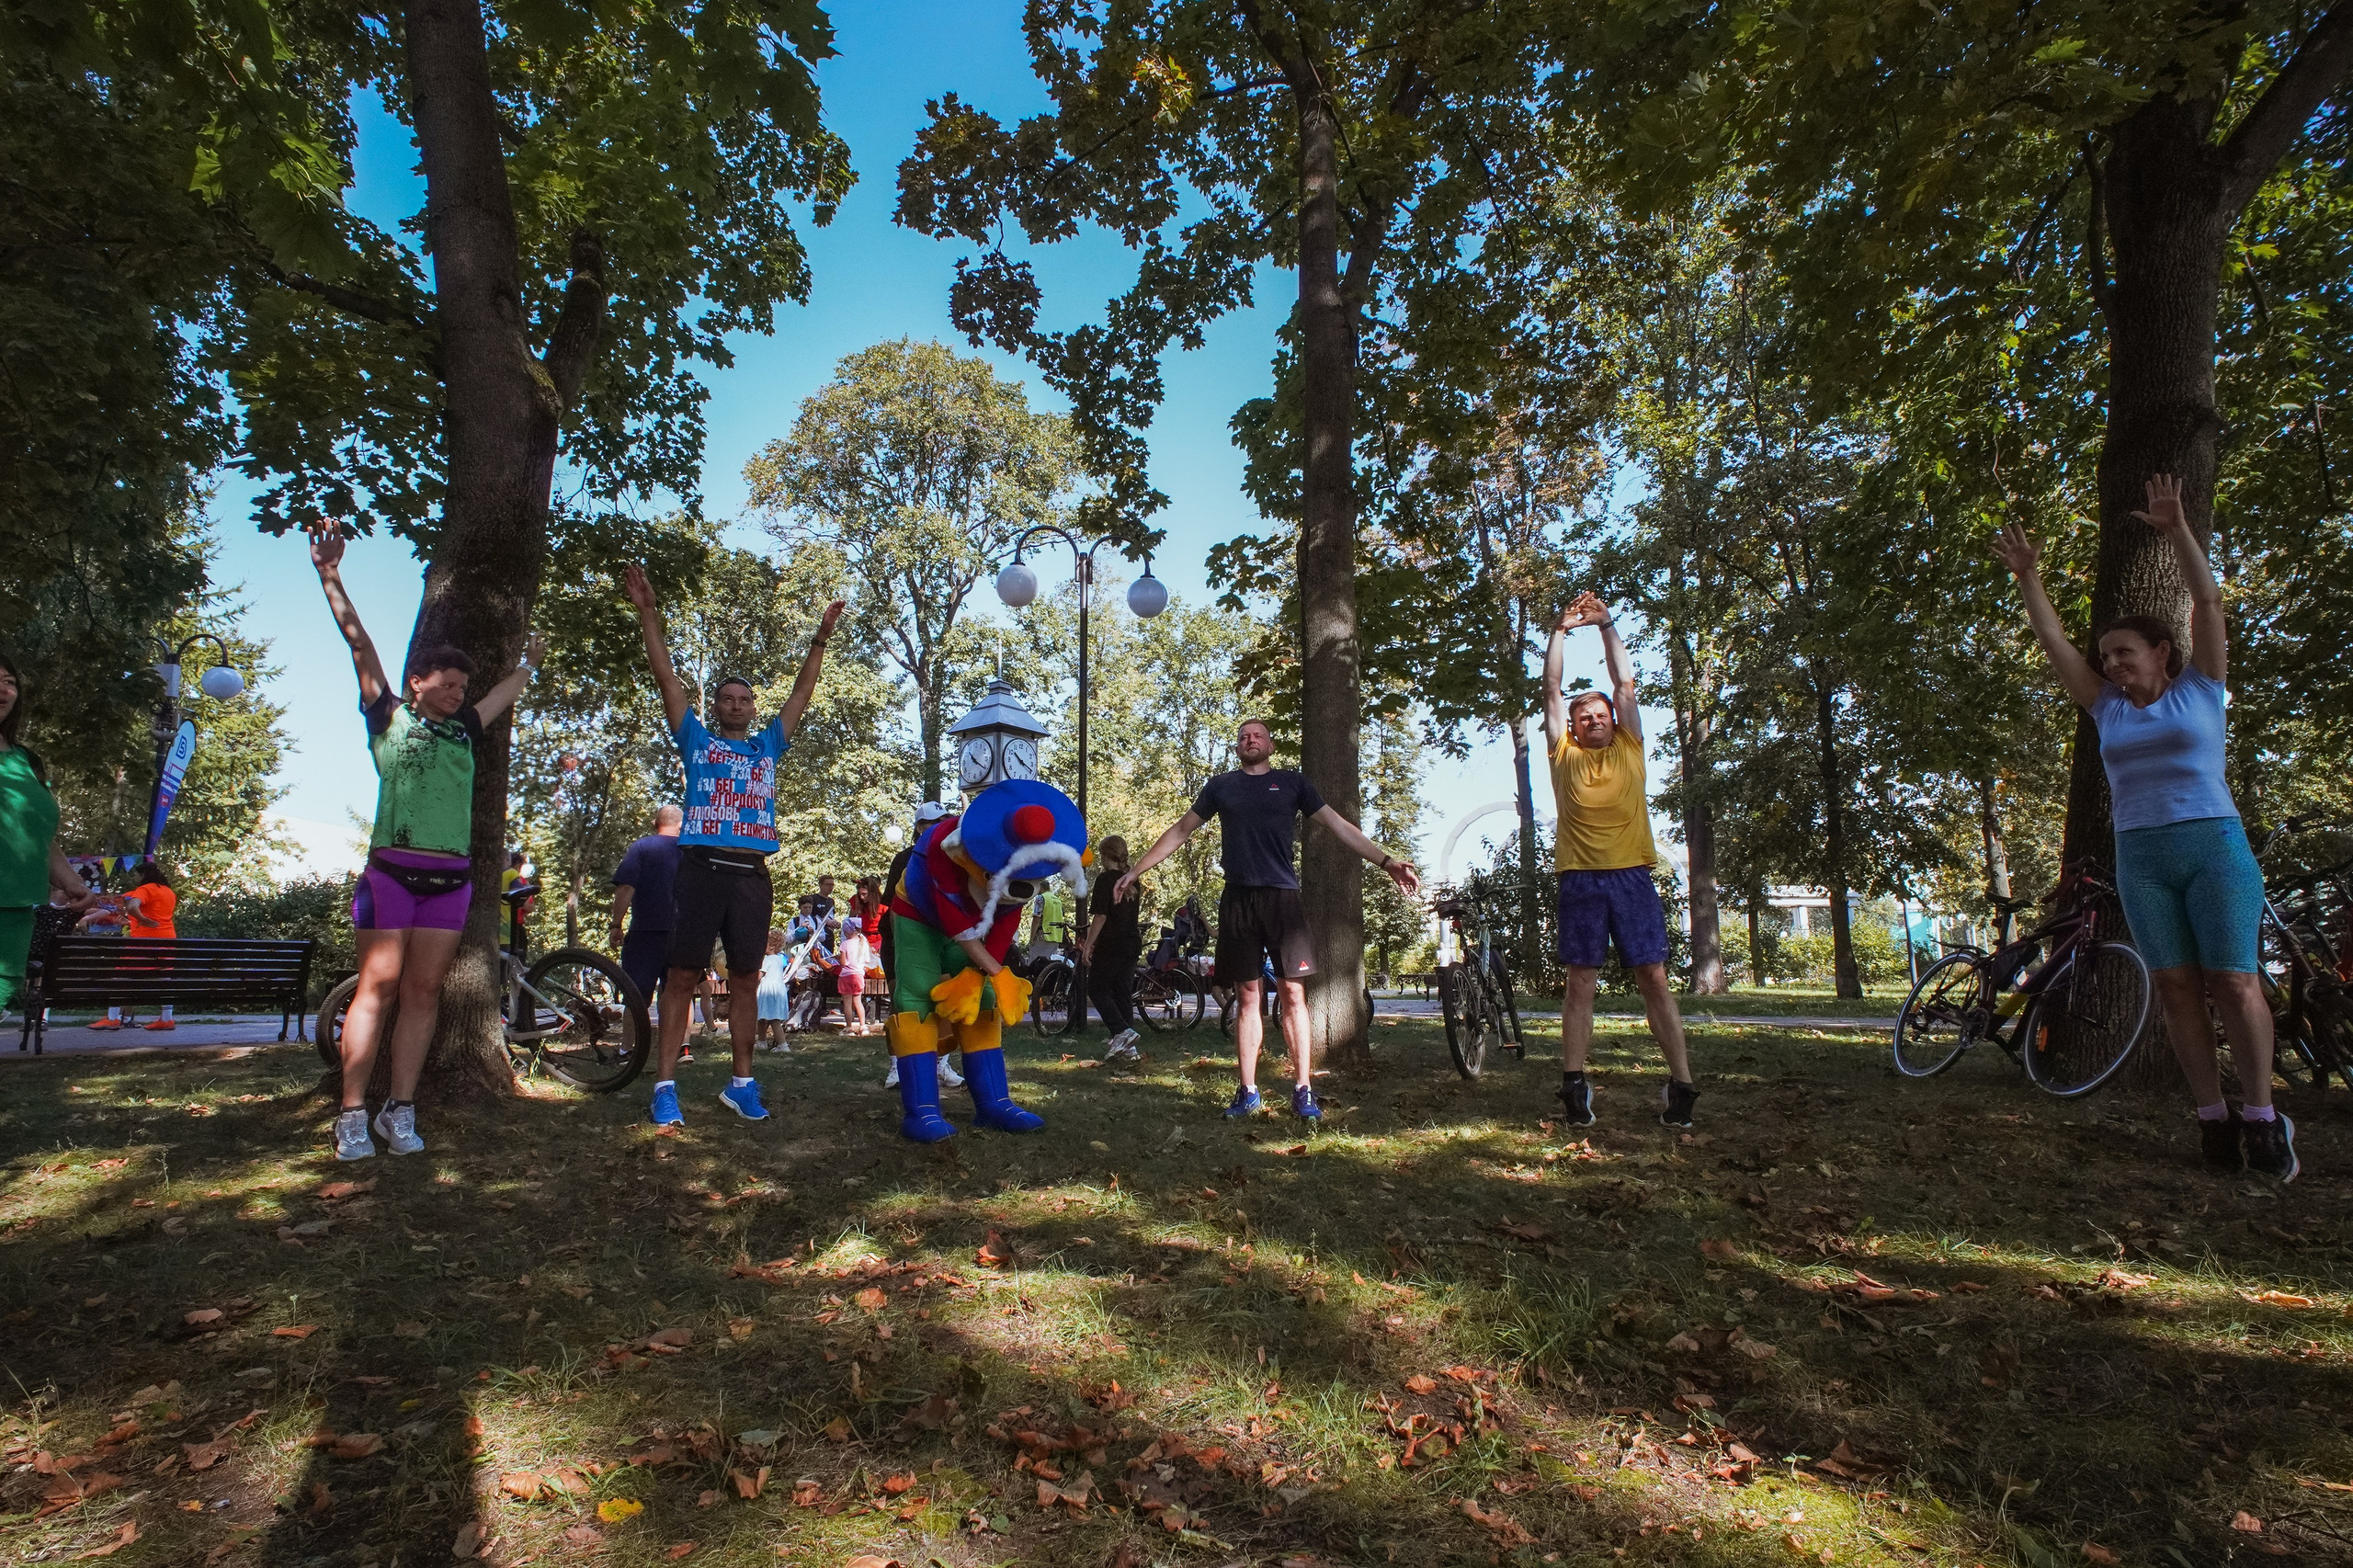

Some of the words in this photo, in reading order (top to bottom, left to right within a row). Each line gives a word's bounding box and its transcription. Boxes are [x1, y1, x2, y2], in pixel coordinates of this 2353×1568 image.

[731, 766, 765, 782] #ЗАБЕ
[698, 778, 735, 793] #ЗАБЕГ
[688, 805, 740, 822] #ЛЮБОВЬ
[684, 820, 722, 835] #ЗАБЕГ
